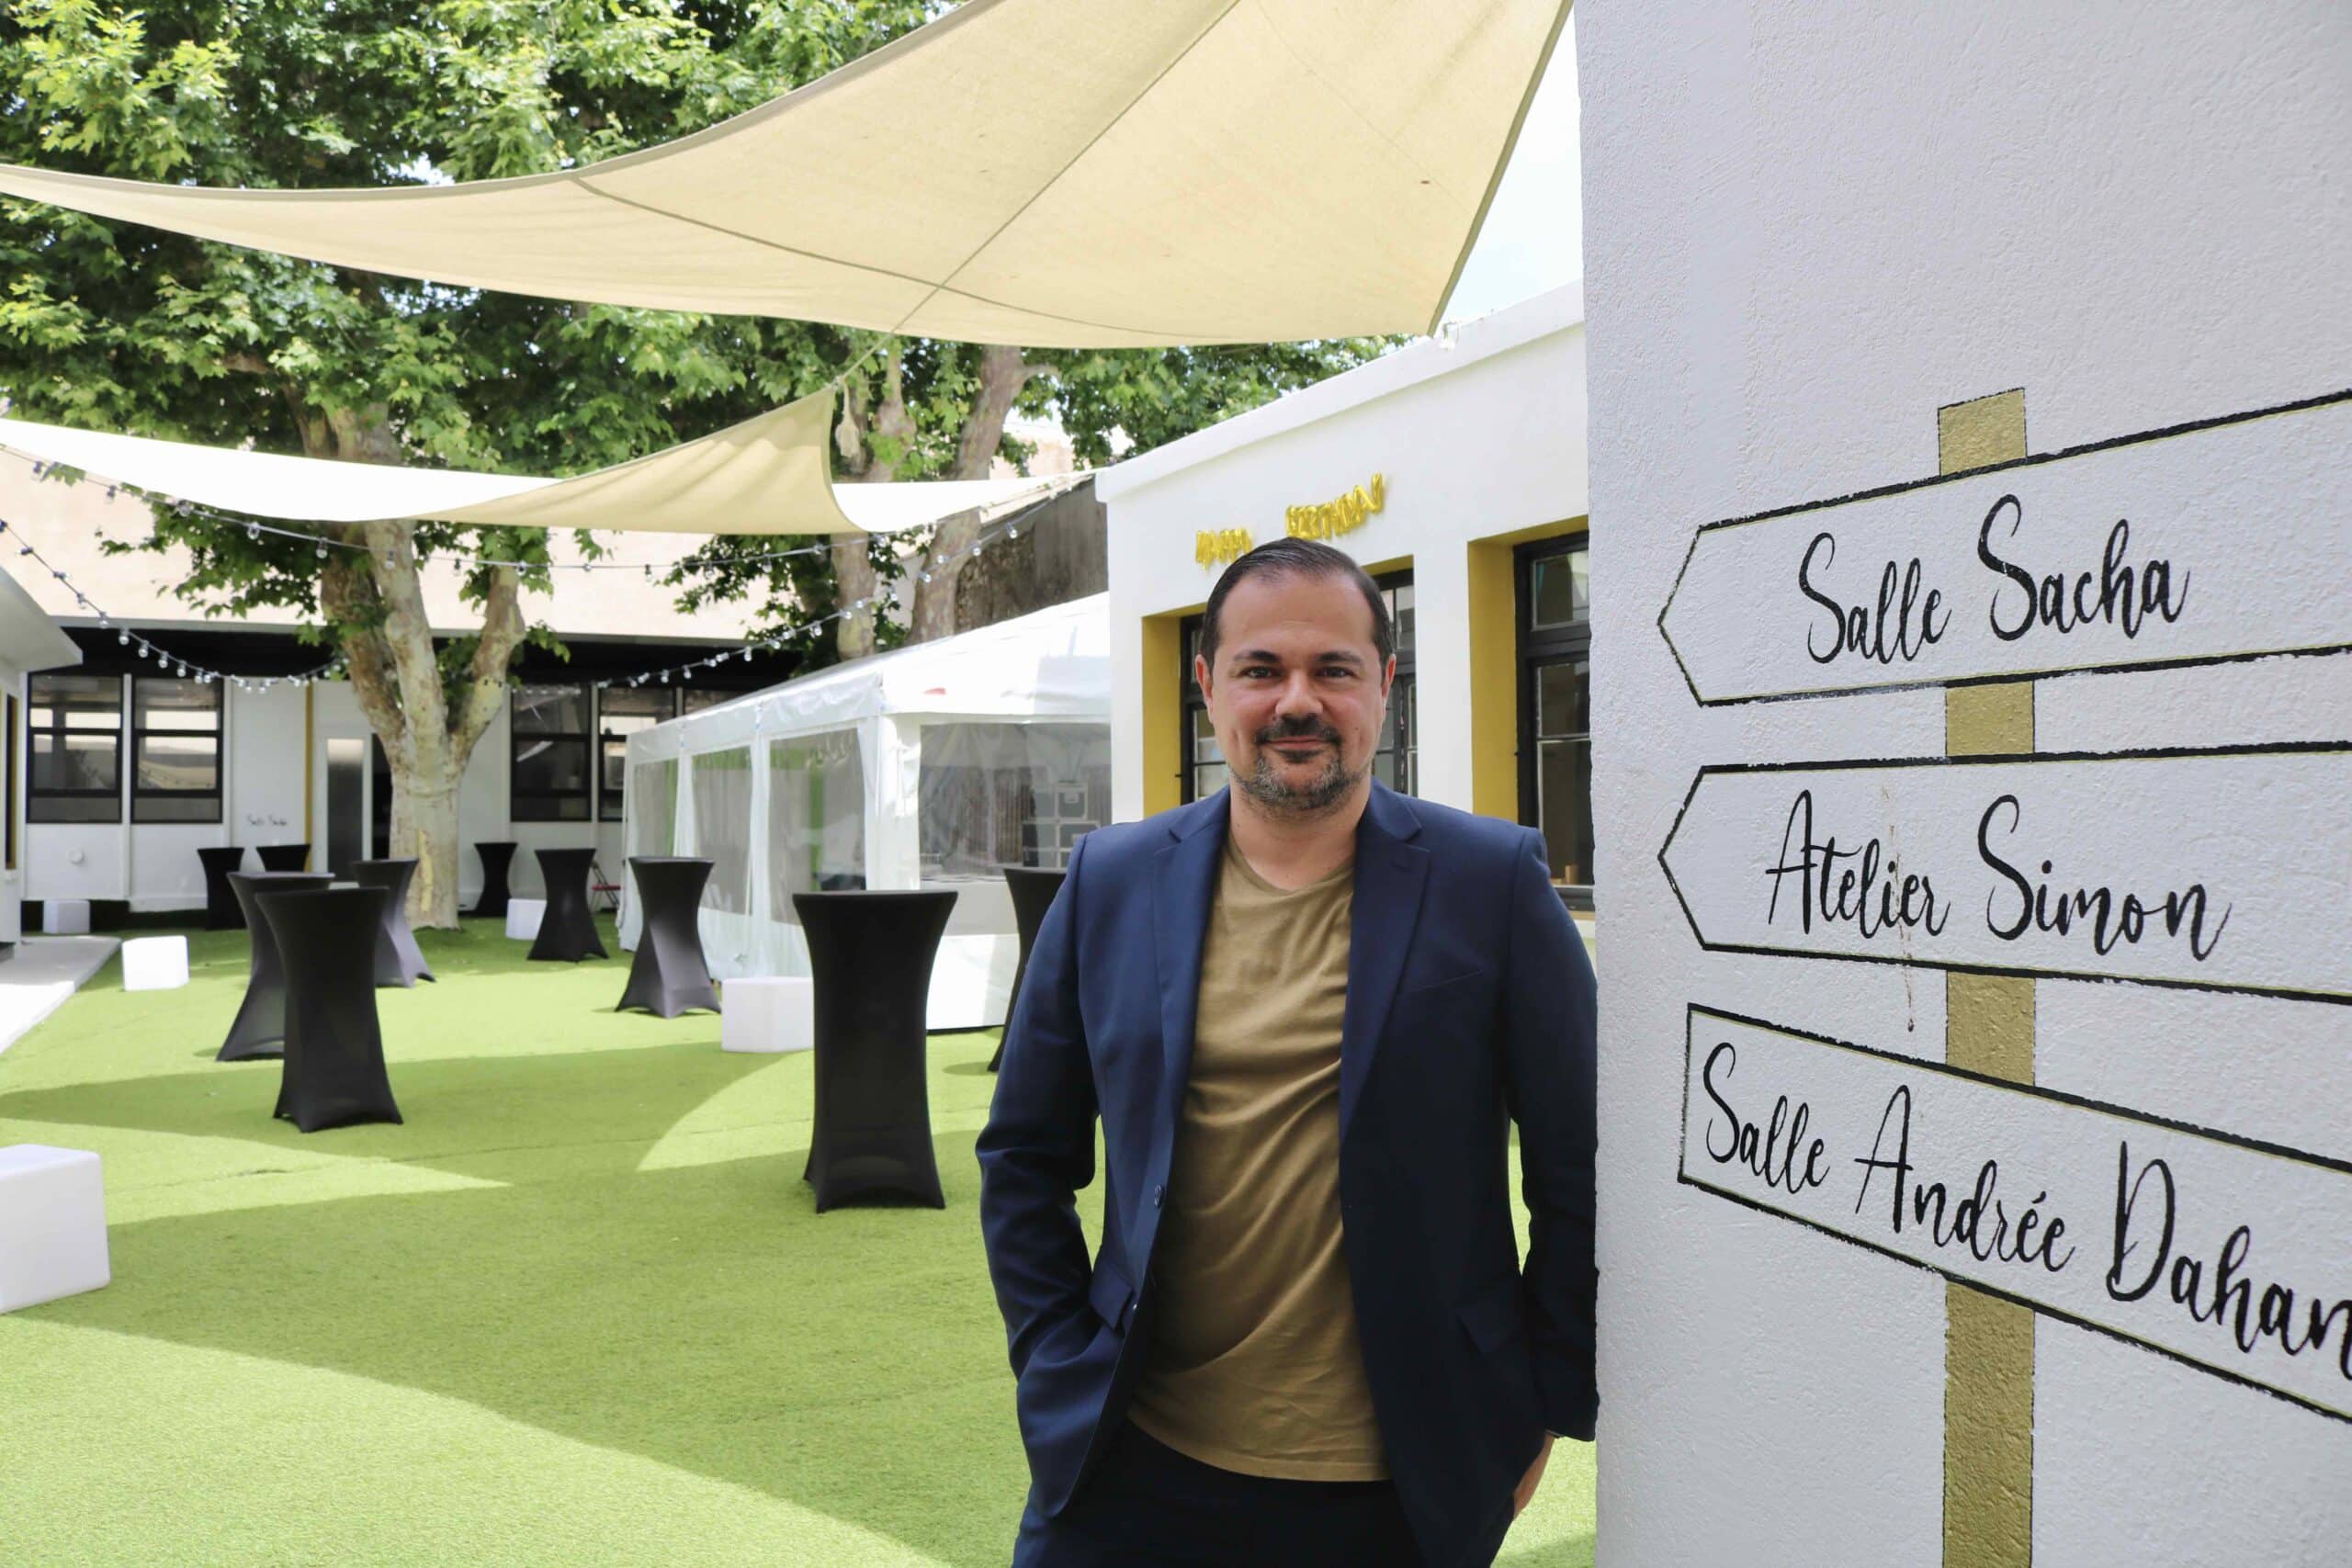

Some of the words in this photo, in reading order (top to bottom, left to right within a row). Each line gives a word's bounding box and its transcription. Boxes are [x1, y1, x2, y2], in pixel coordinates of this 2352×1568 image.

[1798, 532, 1952, 665] Salle
[1977, 493, 2190, 641] Sacha
[1765, 789, 1951, 939] Atelier
[1977, 794, 2233, 962] Simon
[1702, 1042, 1830, 1194] Salle
[1854, 1084, 2075, 1273] Andrée
[2105, 1140, 2352, 1381] Dahan
